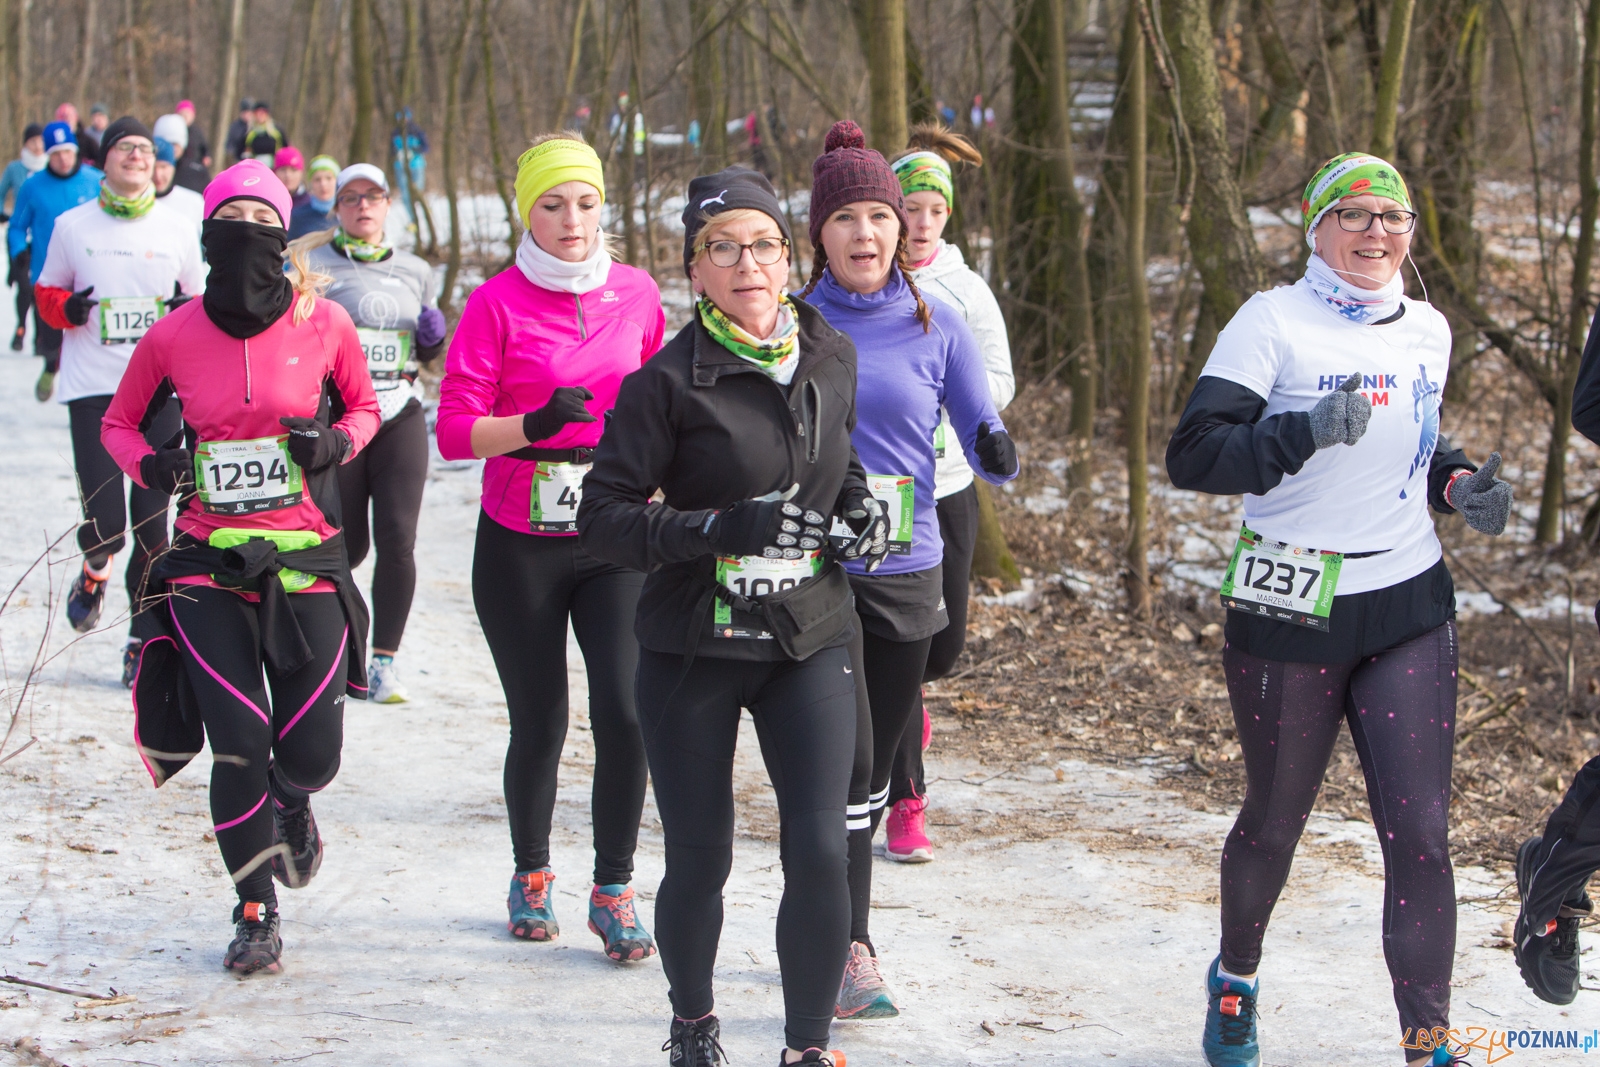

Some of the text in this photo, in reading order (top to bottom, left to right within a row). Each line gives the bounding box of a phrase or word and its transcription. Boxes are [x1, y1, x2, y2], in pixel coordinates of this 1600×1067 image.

[113, 311, 155, 329] 1126
[1318, 374, 1398, 391] HENIK
[209, 458, 288, 491] 1294
[236, 490, 266, 500] JOANNA
[1243, 556, 1320, 599] 1237
[1256, 593, 1293, 608] MARZENA
[1320, 579, 1332, 608] Poznań
